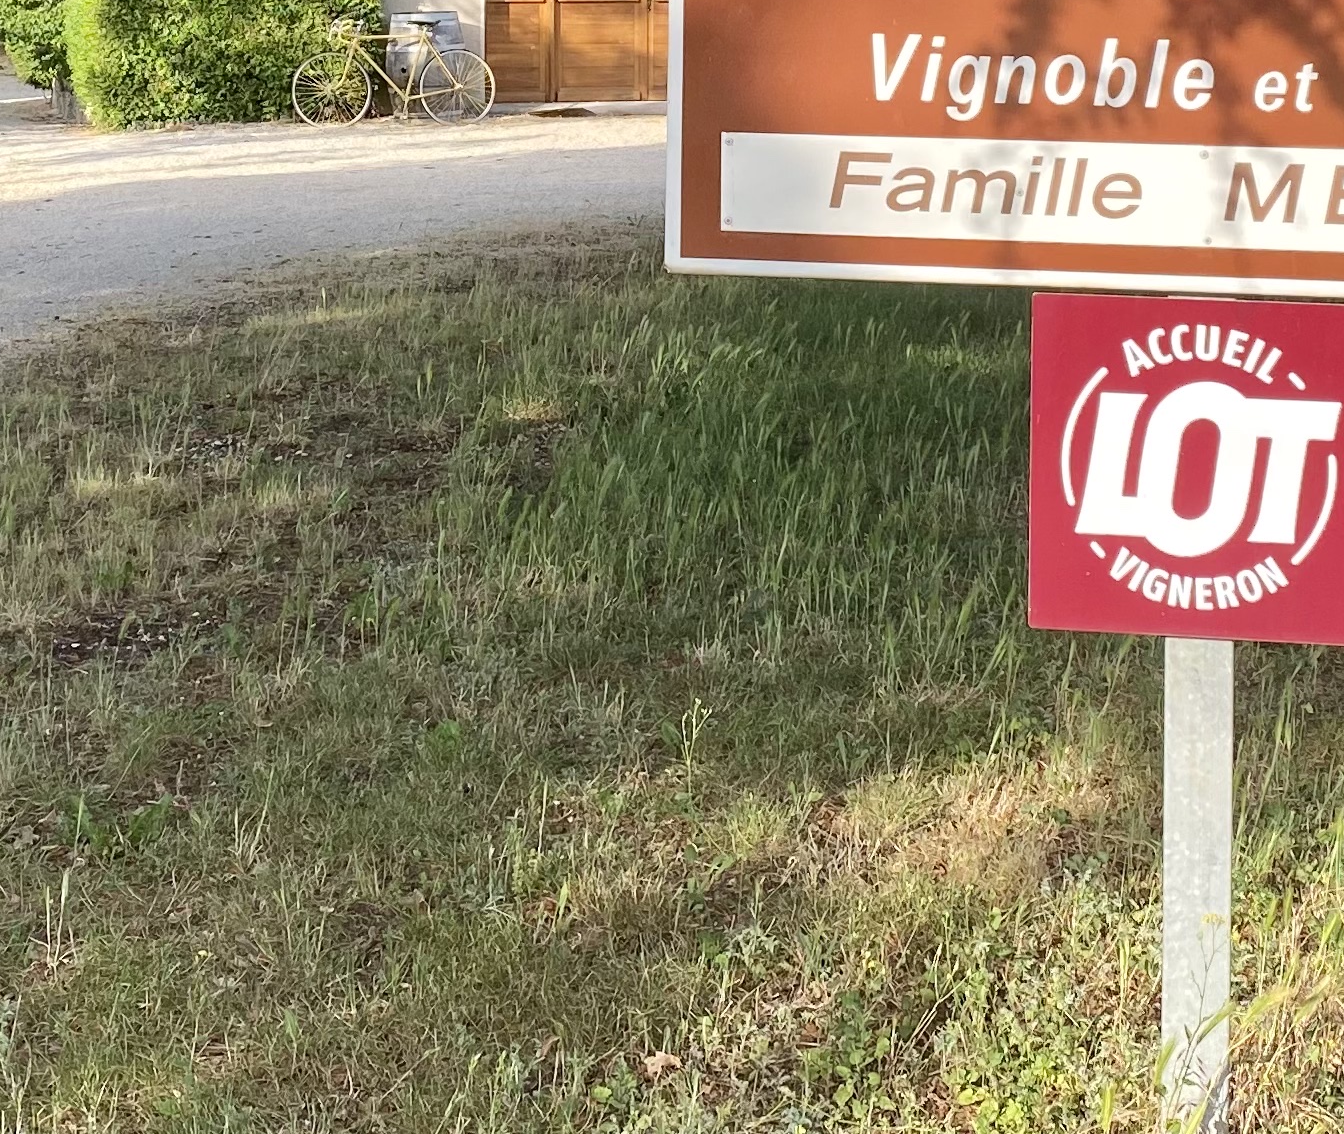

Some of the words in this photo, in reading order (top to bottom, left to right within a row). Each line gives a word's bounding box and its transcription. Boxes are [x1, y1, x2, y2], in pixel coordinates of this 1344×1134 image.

[868, 32, 1216, 121] Vignoble
[1254, 54, 1318, 113] et
[828, 150, 1143, 220] Famille
[1122, 323, 1283, 385] ACCUEIL
[1074, 380, 1343, 558] LOT
[1109, 545, 1290, 611] VIGNERON
